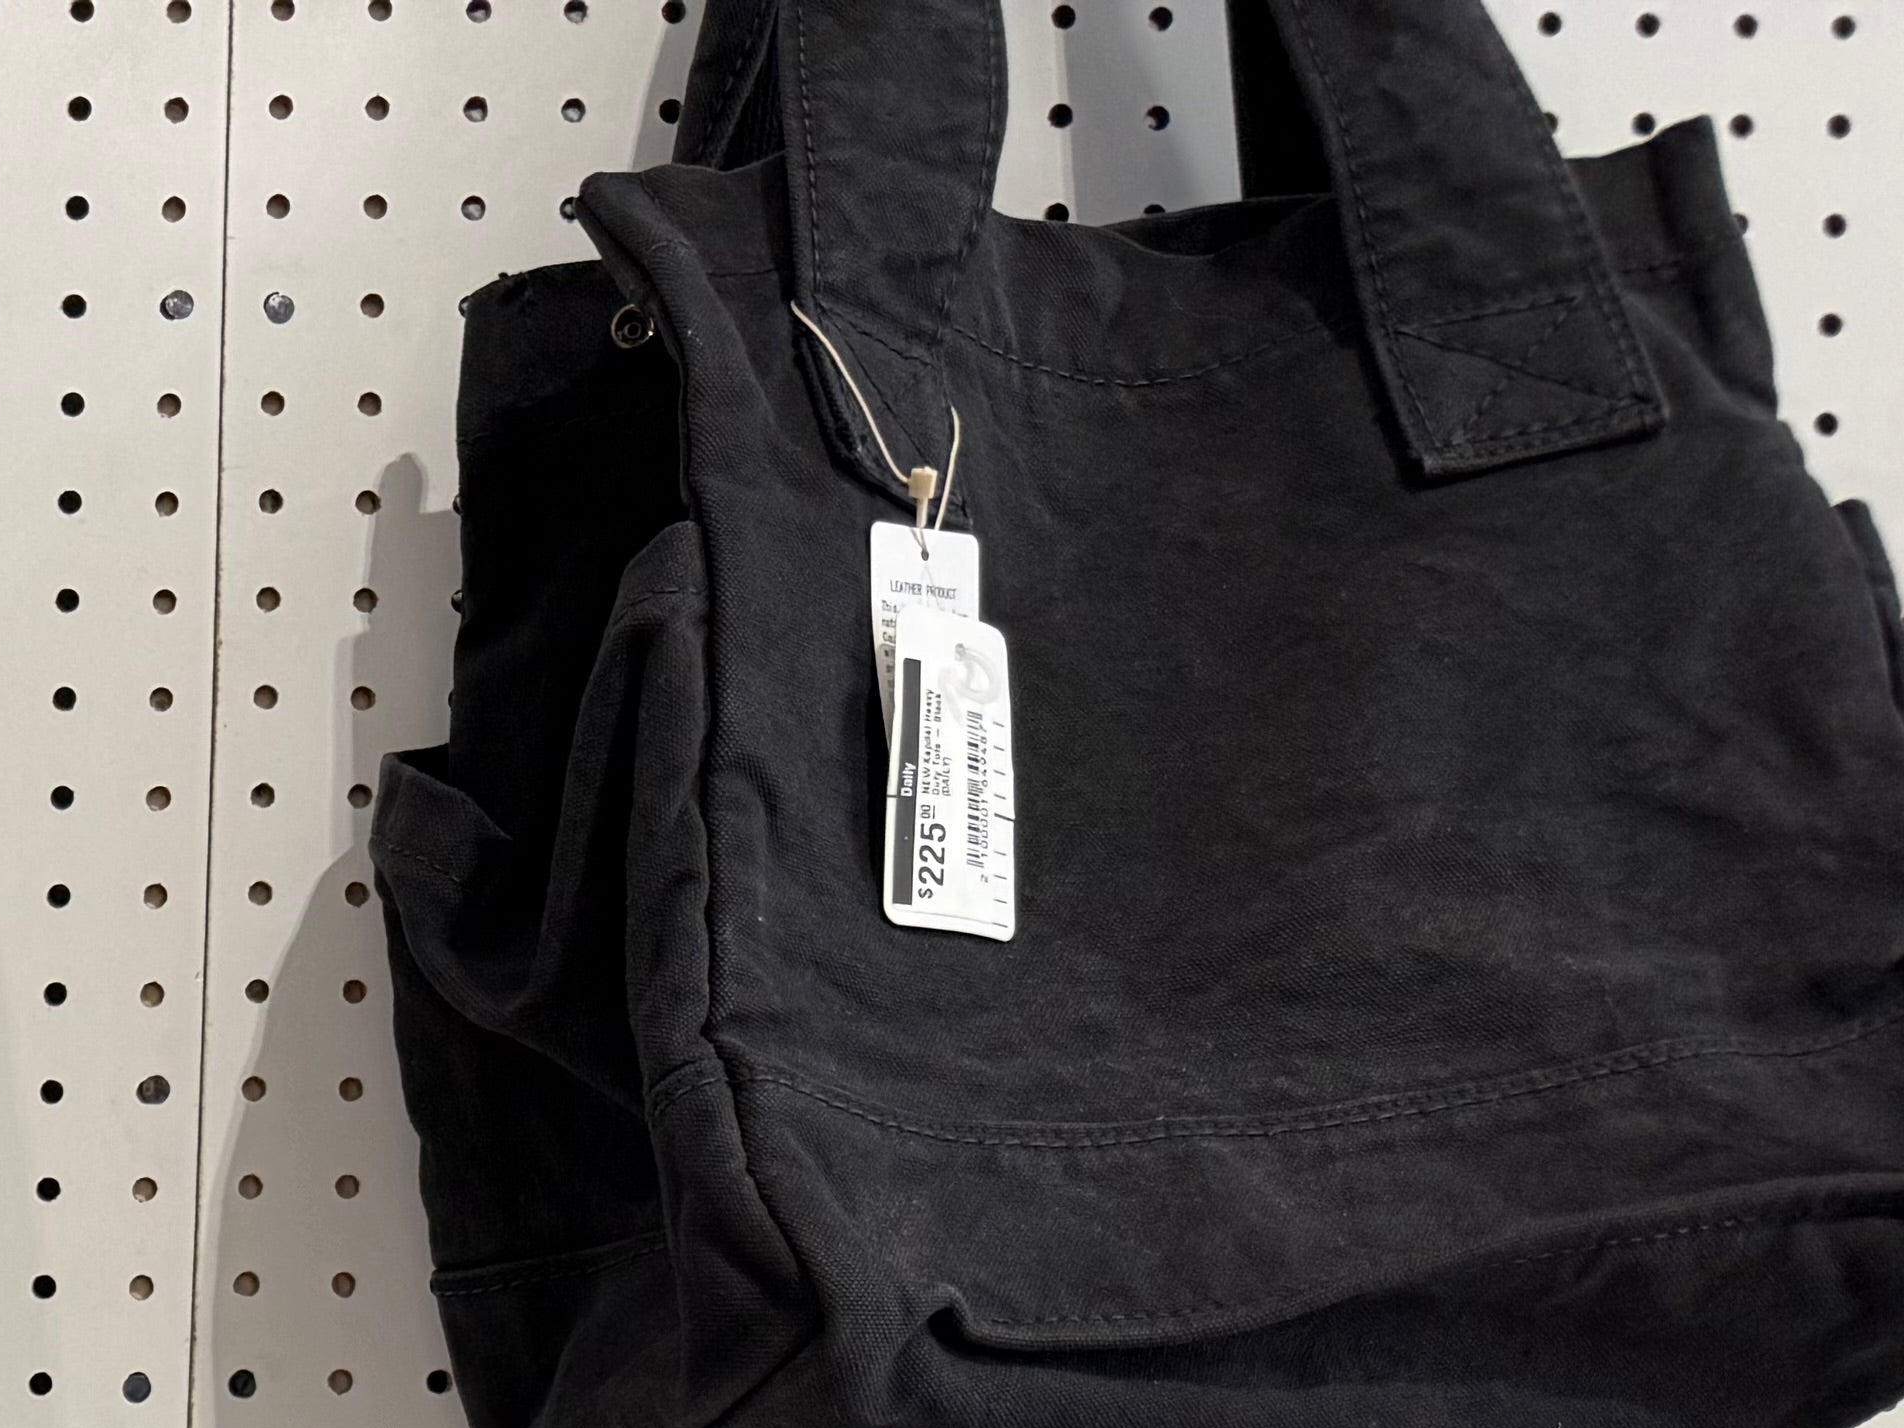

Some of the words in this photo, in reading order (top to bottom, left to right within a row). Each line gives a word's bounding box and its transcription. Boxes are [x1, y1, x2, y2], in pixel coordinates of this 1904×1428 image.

[890, 580, 922, 595] LEATHER
[926, 585, 957, 600] PRODUCT
[900, 761, 917, 797] Daily
